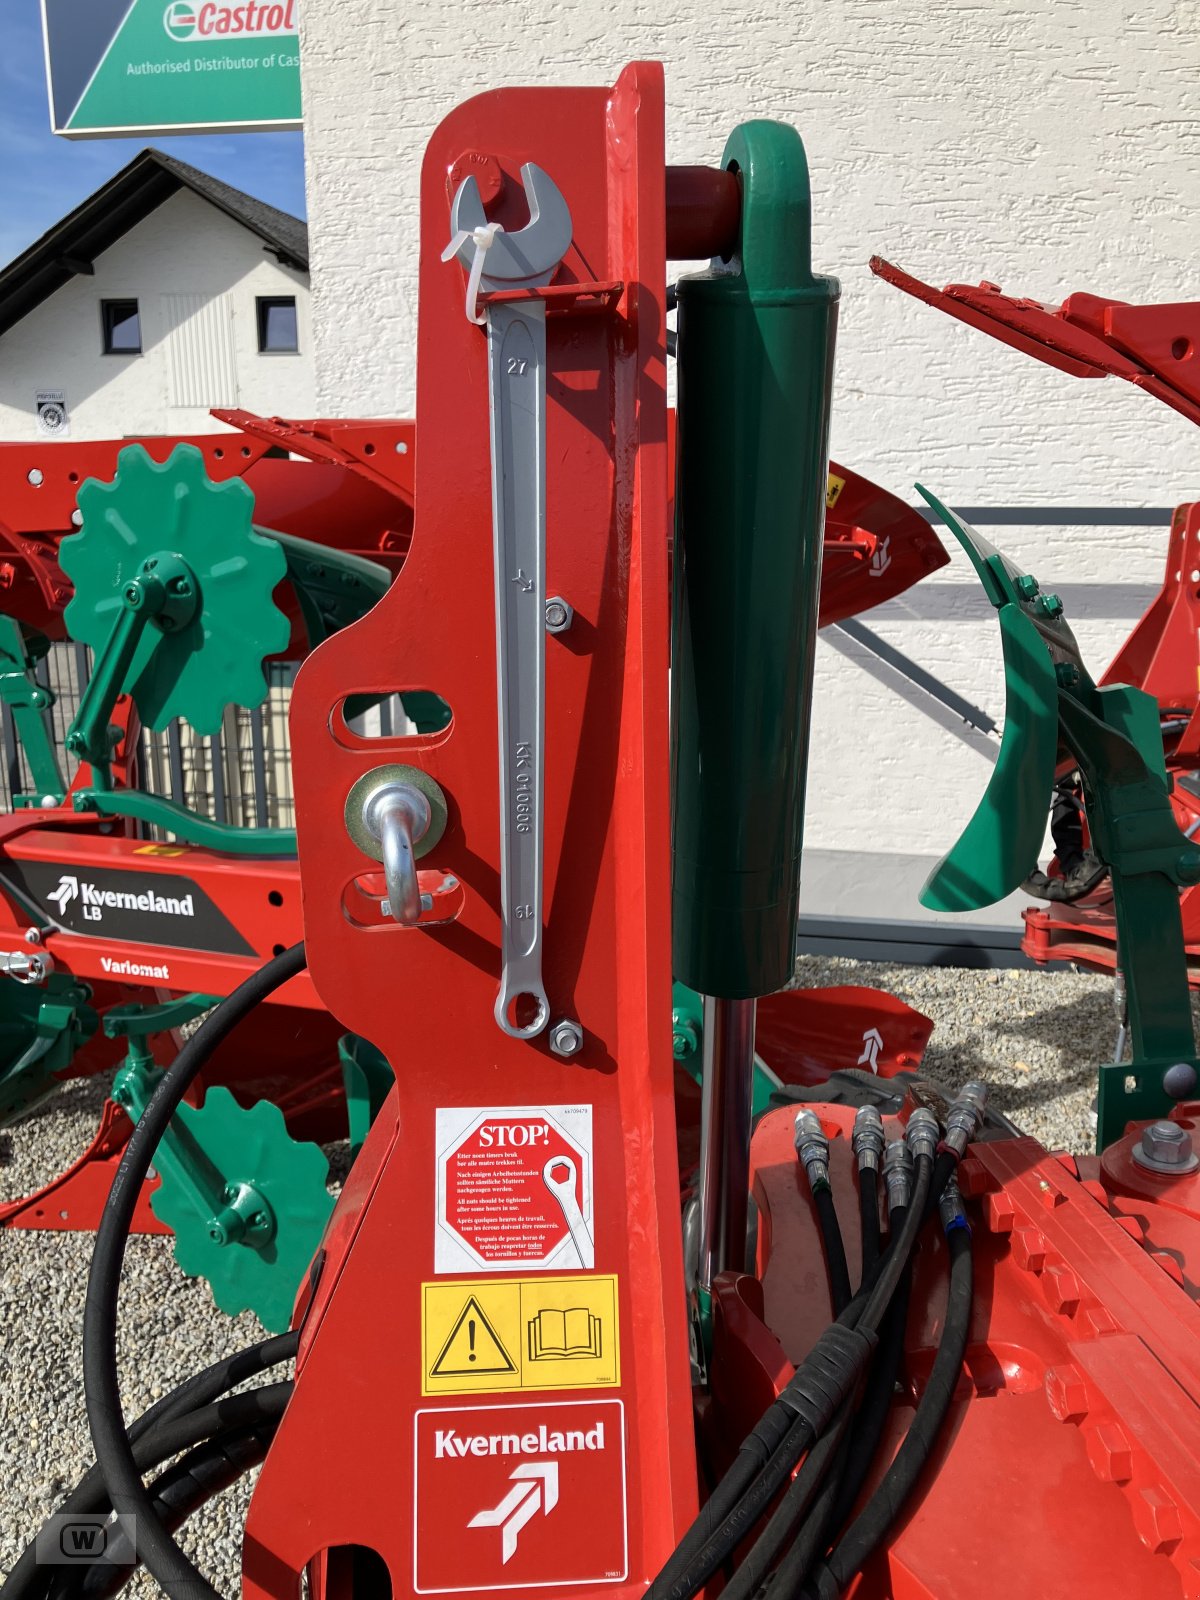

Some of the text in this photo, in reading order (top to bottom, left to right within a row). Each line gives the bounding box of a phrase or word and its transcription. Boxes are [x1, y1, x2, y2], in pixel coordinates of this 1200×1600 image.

[198, 0, 294, 35] Castrol
[127, 58, 191, 76] Authorised
[194, 56, 258, 72] Distributor
[262, 54, 276, 68] of
[508, 358, 528, 375] 27
[516, 742, 531, 833] KK 010606
[80, 882, 194, 916] Kverneland
[83, 906, 103, 921] LB
[514, 904, 534, 919] 19
[101, 957, 170, 980] Variomat
[479, 1124, 549, 1147] STOP!
[434, 1422, 605, 1458] Kverneland
